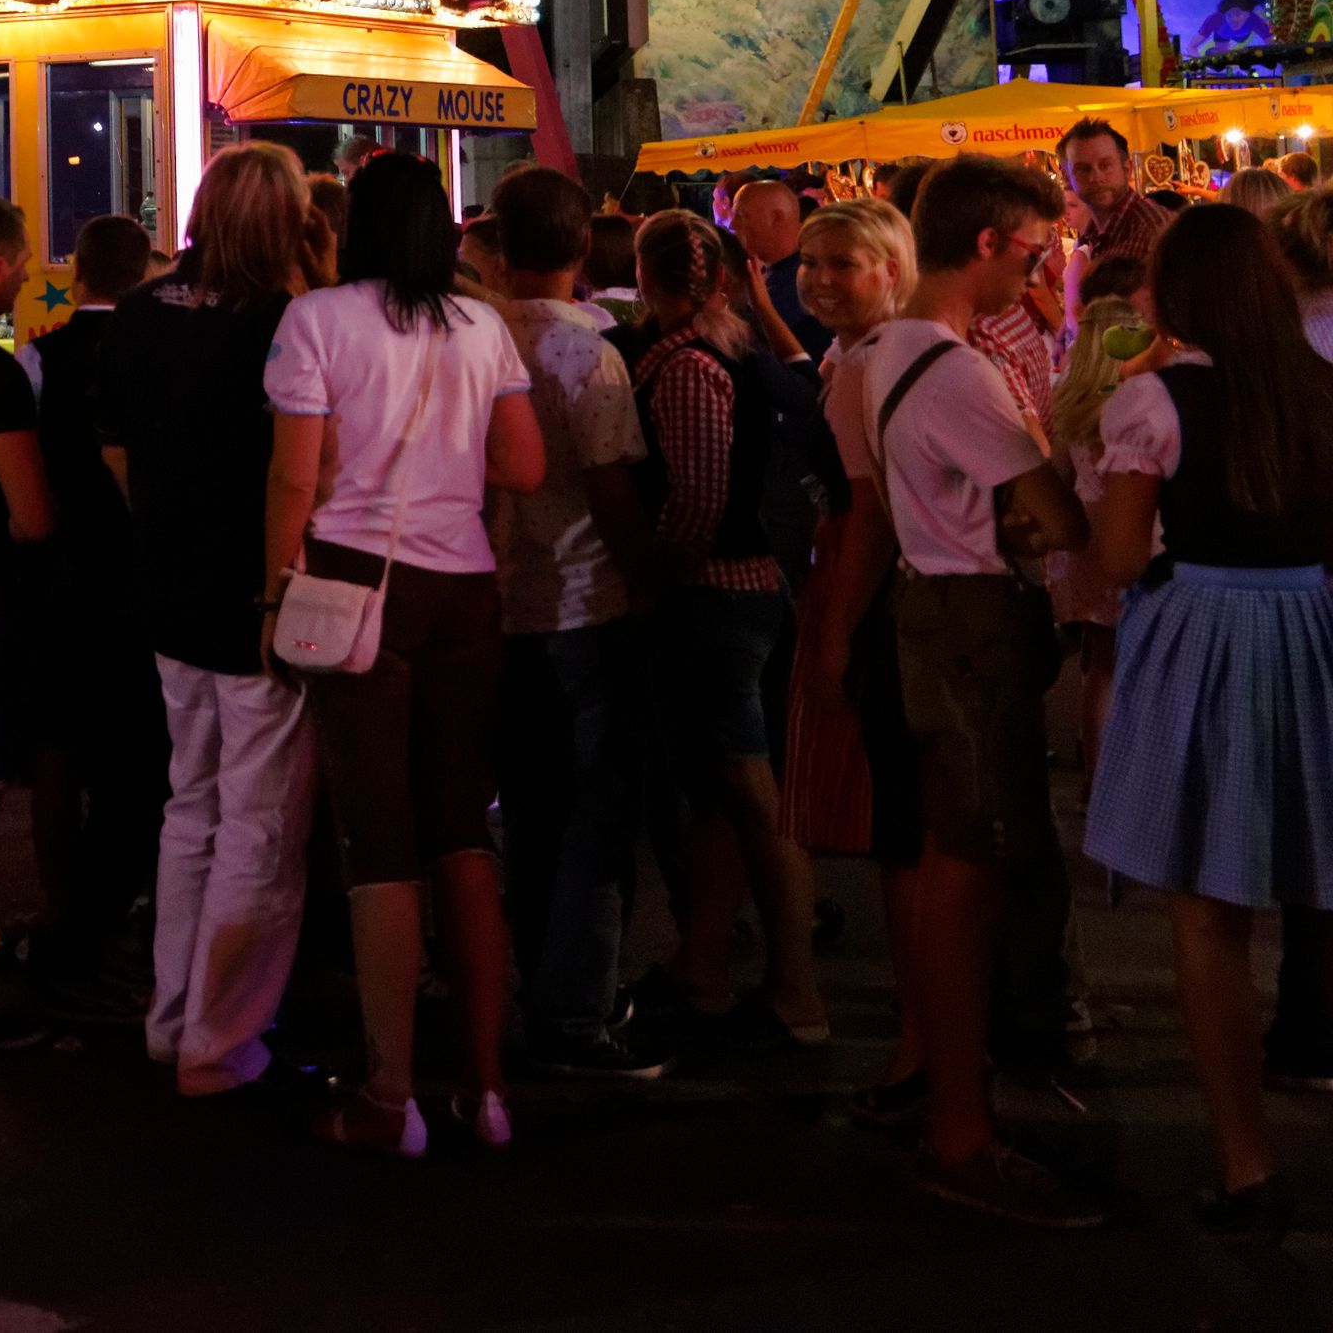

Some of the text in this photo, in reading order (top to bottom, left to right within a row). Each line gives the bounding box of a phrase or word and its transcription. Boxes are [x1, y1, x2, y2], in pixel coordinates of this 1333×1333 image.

[342, 81, 506, 123] CRAZY MOUSE
[972, 122, 1066, 144] naschmax
[720, 138, 800, 159] naschmax
